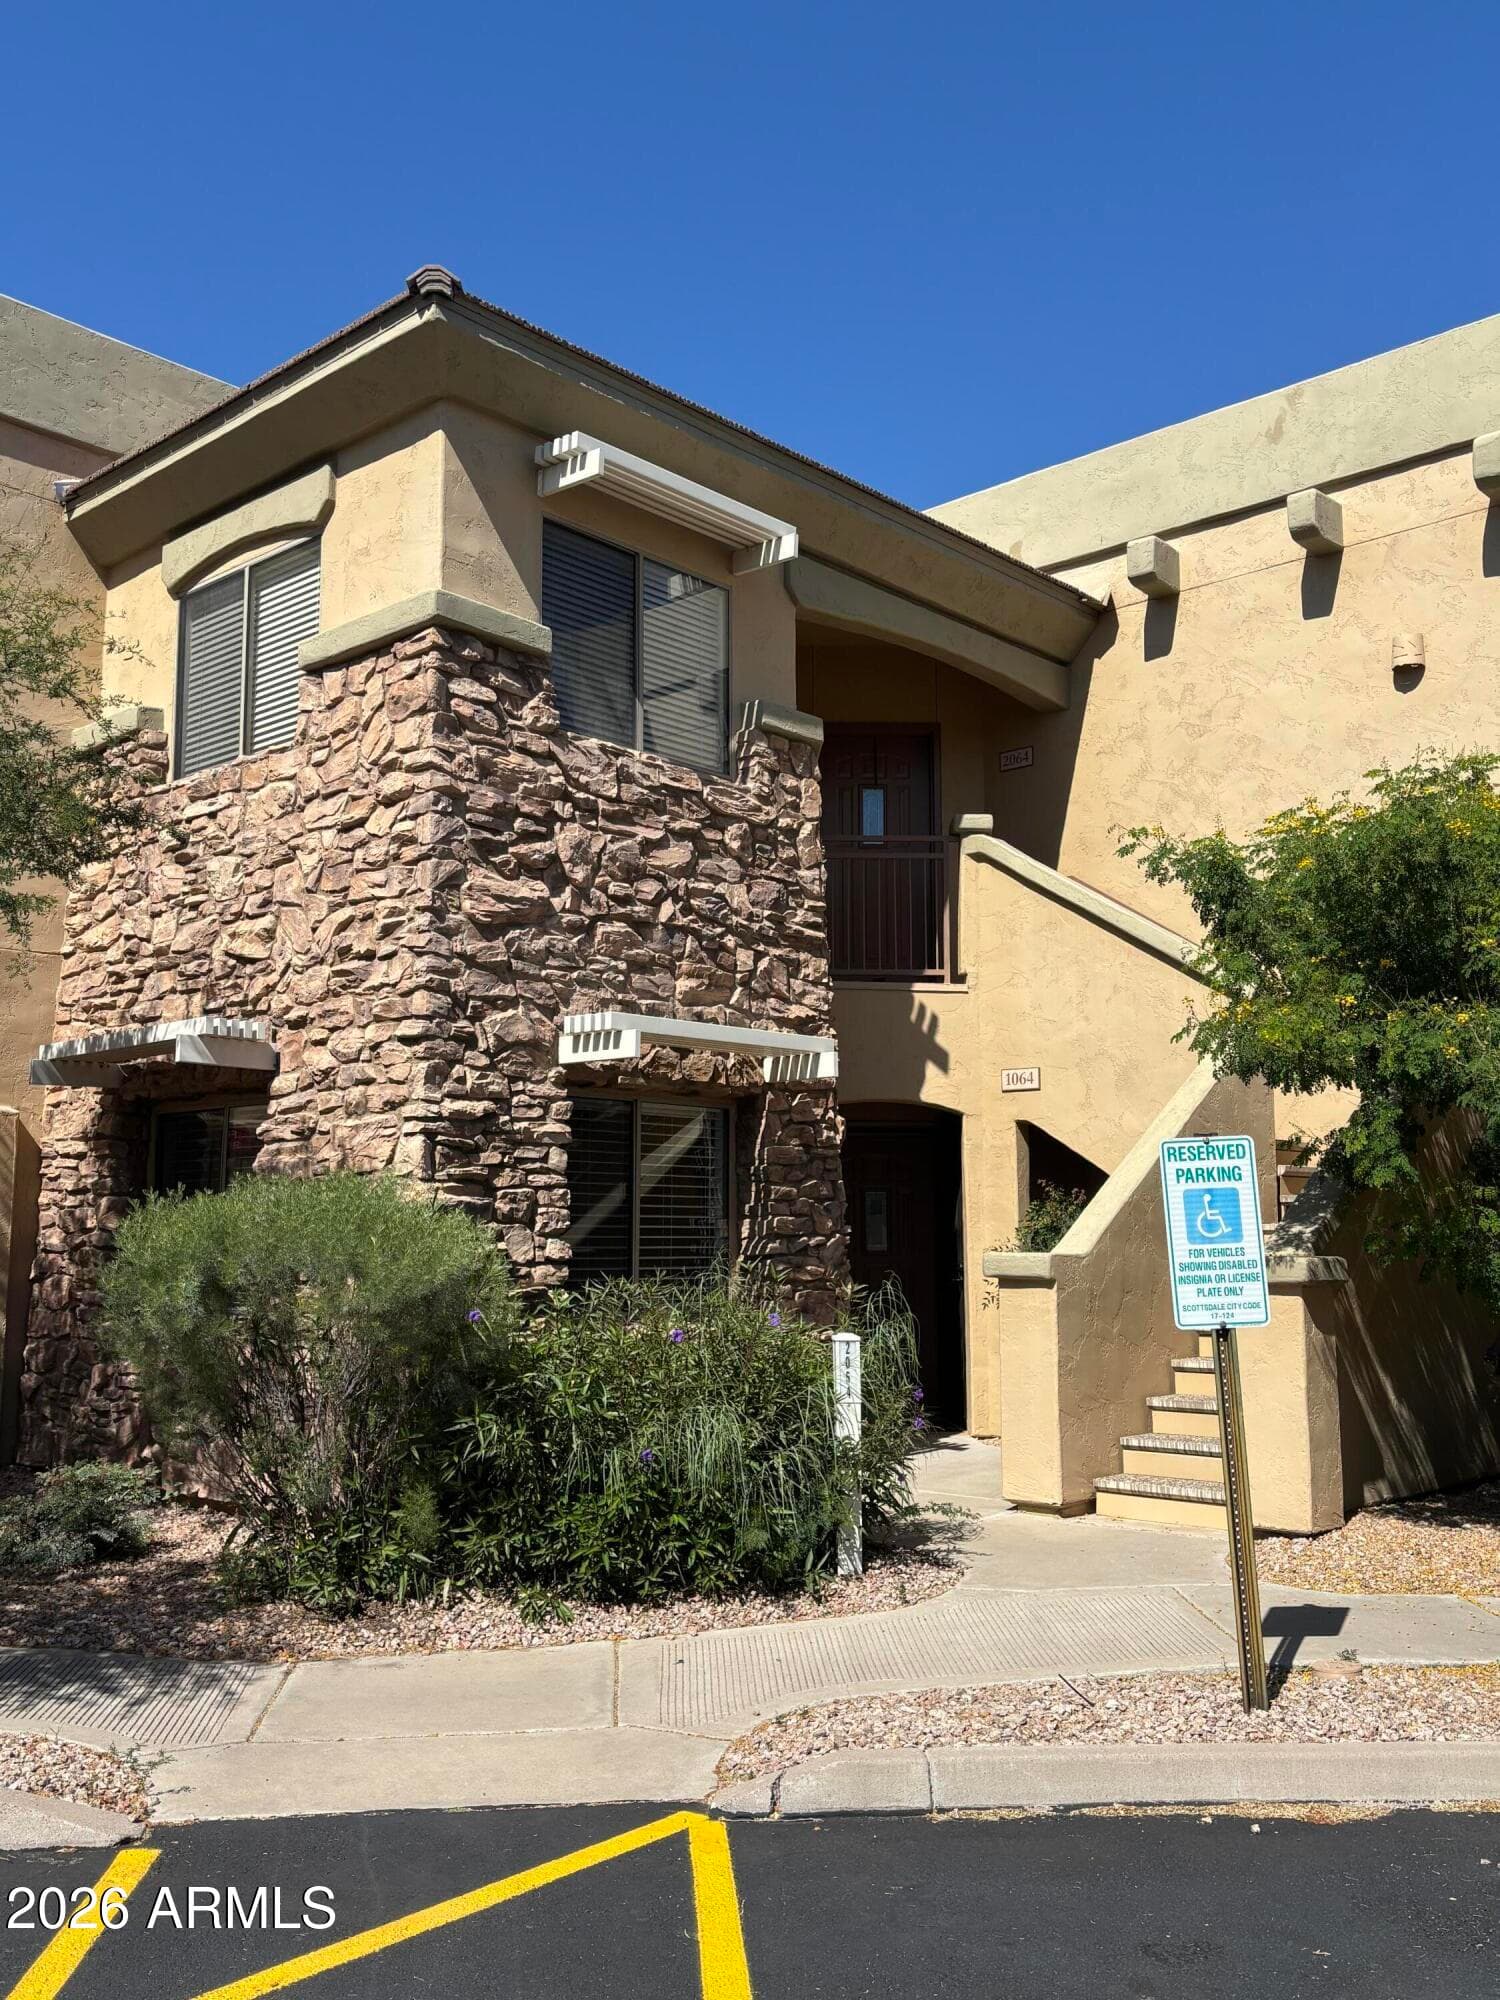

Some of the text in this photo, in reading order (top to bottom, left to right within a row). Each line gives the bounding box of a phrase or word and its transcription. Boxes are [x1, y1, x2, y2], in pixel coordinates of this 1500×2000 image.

[1002, 750, 1030, 767] 2064
[1006, 1071, 1034, 1086] 1064
[1166, 1143, 1246, 1163] RESERVED
[1175, 1165, 1243, 1184] PARKING
[1188, 1247, 1246, 1259] FOR VEHICLES
[1178, 1259, 1258, 1272] SHOWING DISABLED
[1178, 1272, 1261, 1285] INSIGNIA OR LICENSE
[1196, 1286, 1244, 1298] PLATE ONLY
[1182, 1302, 1262, 1312] SCOTTSDALE CITY CODE
